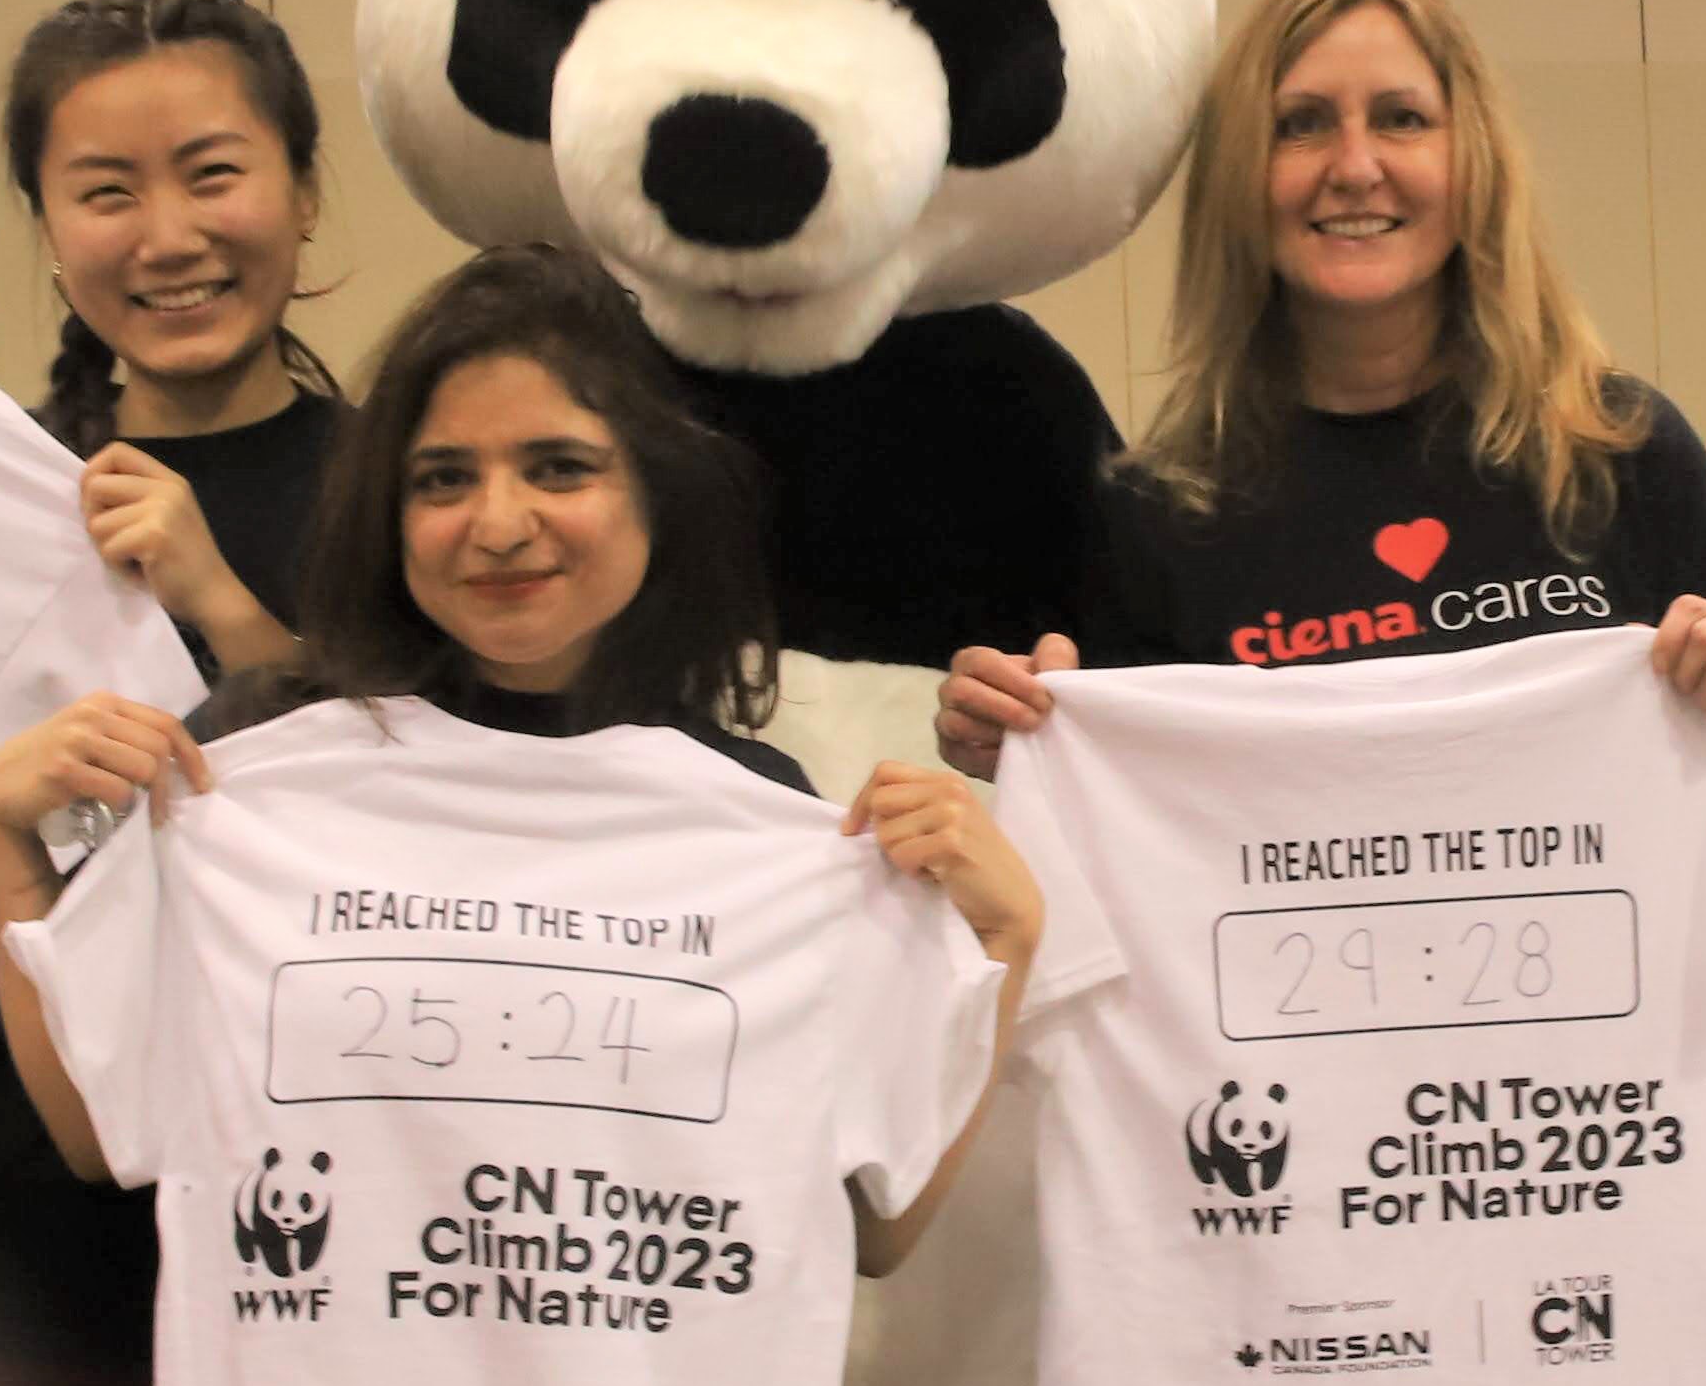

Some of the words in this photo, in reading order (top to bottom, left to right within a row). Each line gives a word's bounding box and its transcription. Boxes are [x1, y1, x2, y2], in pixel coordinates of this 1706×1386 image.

[1230, 601, 1419, 666] ciena
[1431, 572, 1612, 631] cares
[1241, 844, 1251, 885] I
[1263, 835, 1410, 882] REACHED
[1423, 830, 1486, 873] THE
[1497, 826, 1561, 868] TOP
[1574, 823, 1605, 865] IN
[310, 893, 321, 936] I
[331, 889, 499, 934] REACHED
[514, 902, 585, 941] THE
[597, 913, 670, 948] TOP
[682, 914, 715, 957] IN
[1406, 1080, 1488, 1127] CN
[1501, 1077, 1664, 1120] Tower
[1368, 1129, 1526, 1179] Climb
[1537, 1115, 1686, 1174] 2023
[464, 1163, 556, 1217] CN
[574, 1169, 742, 1233] Tower
[1192, 1203, 1292, 1236] WWF
[1340, 1184, 1426, 1230] For
[1441, 1173, 1623, 1224] Nature
[421, 1217, 593, 1274] Climb
[605, 1230, 756, 1294] 2023
[234, 1288, 333, 1322] WWF
[387, 1271, 484, 1320] For
[497, 1276, 674, 1334] Nature
[1533, 1278, 1558, 1297] LA
[1561, 1274, 1614, 1294] TOUR
[1270, 1330, 1431, 1363] NISSAN
[1531, 1293, 1614, 1345] CN
[1534, 1342, 1615, 1367] TOWER
